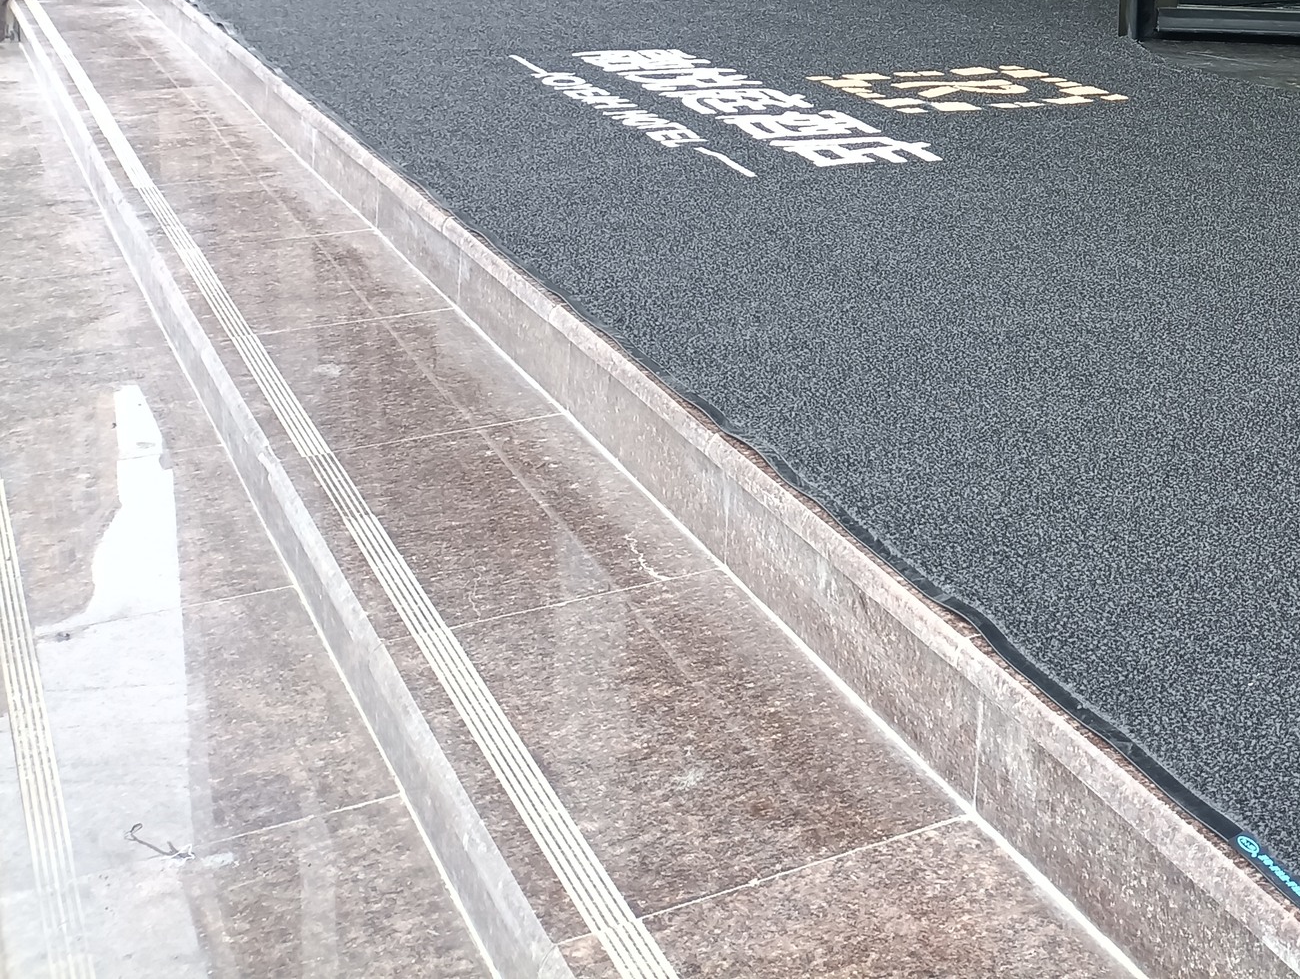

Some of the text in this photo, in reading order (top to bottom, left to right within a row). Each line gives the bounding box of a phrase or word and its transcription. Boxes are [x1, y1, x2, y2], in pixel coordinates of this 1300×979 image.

[573, 48, 945, 167] 融悦庭酒店
[603, 110, 708, 147] HOTEL
